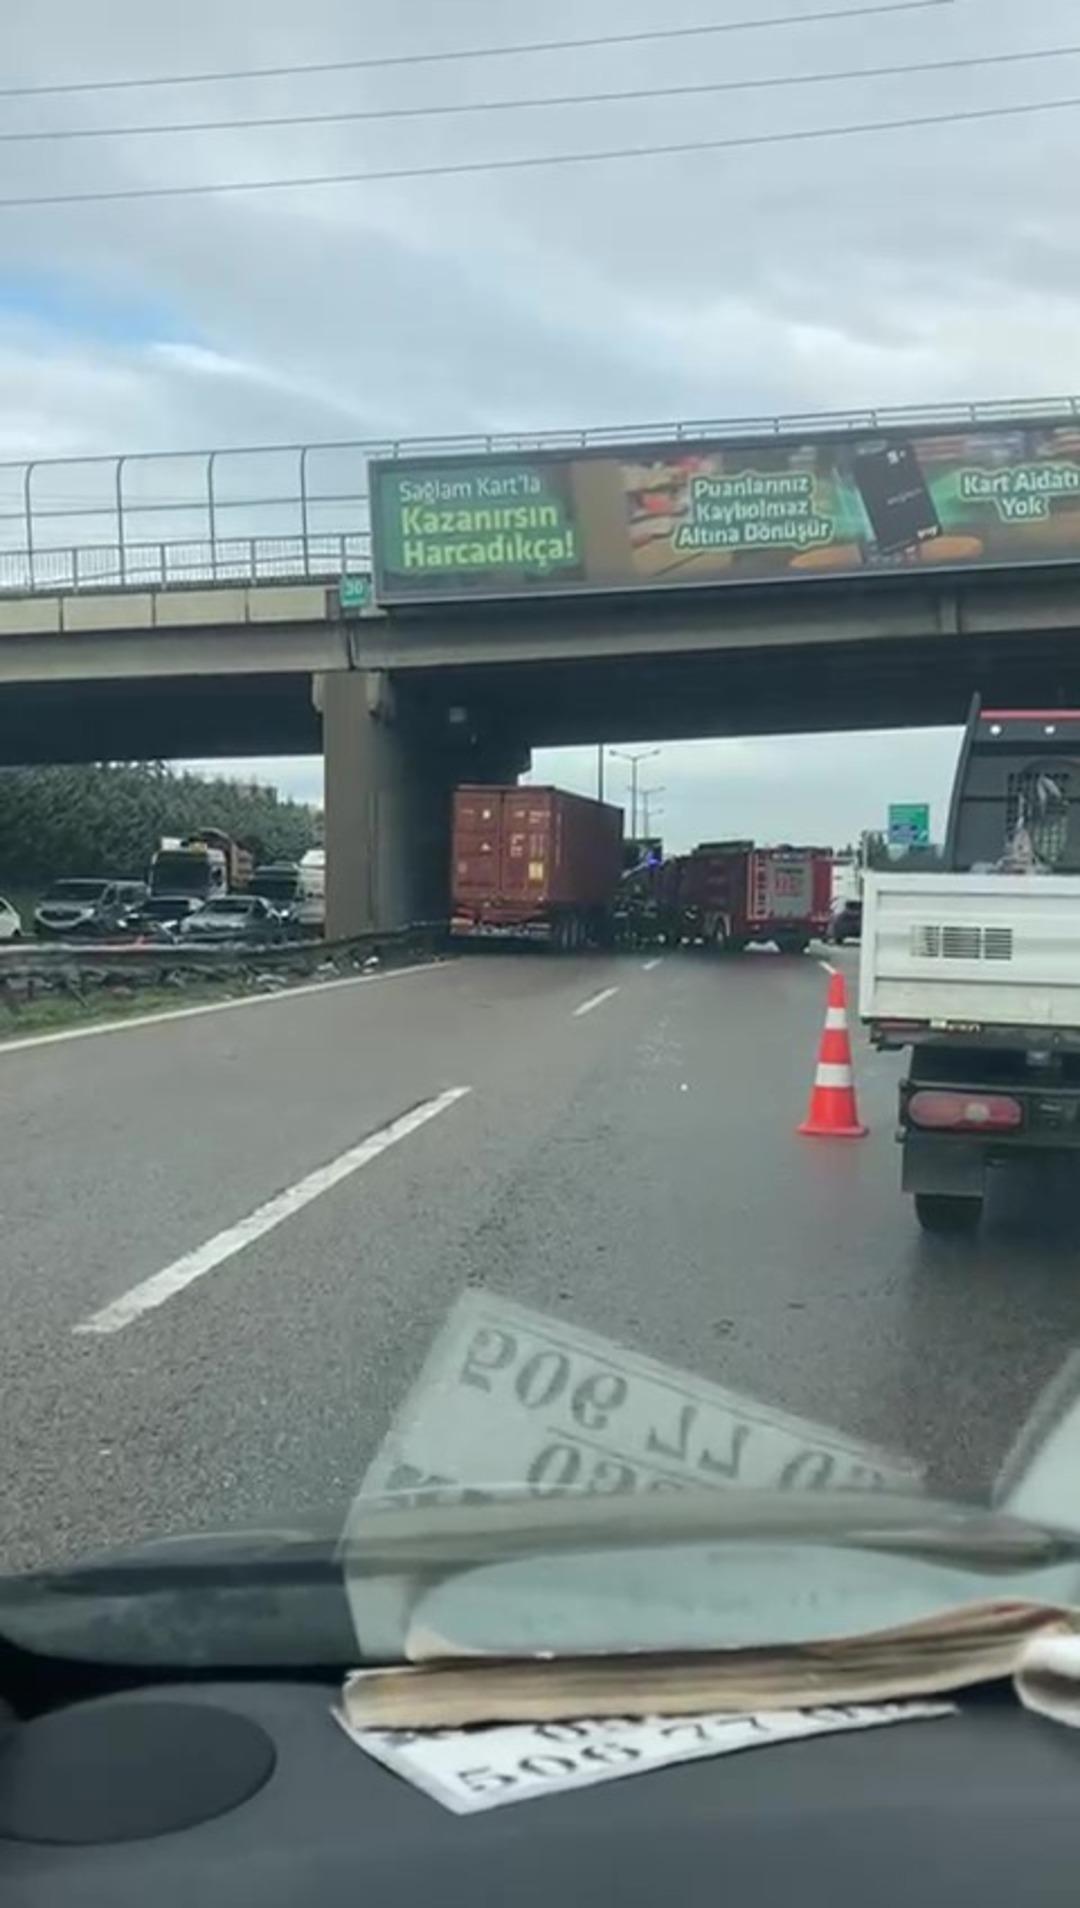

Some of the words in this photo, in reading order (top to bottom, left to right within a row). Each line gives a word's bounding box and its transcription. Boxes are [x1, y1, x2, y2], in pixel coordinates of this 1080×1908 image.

[400, 479, 471, 503] Sağlam
[476, 474, 541, 497] Kart'la
[694, 477, 809, 498] Puanlarınız
[964, 474, 1008, 494] Kart
[697, 499, 809, 525] Kaybolmaz
[1002, 497, 1042, 516] Yok
[402, 505, 557, 535] Kazanırsın
[679, 526, 739, 546] Altına
[744, 520, 829, 543] Dönüşür
[403, 530, 575, 568] Harcadıkça!
[458, 1742, 642, 1793] 506
